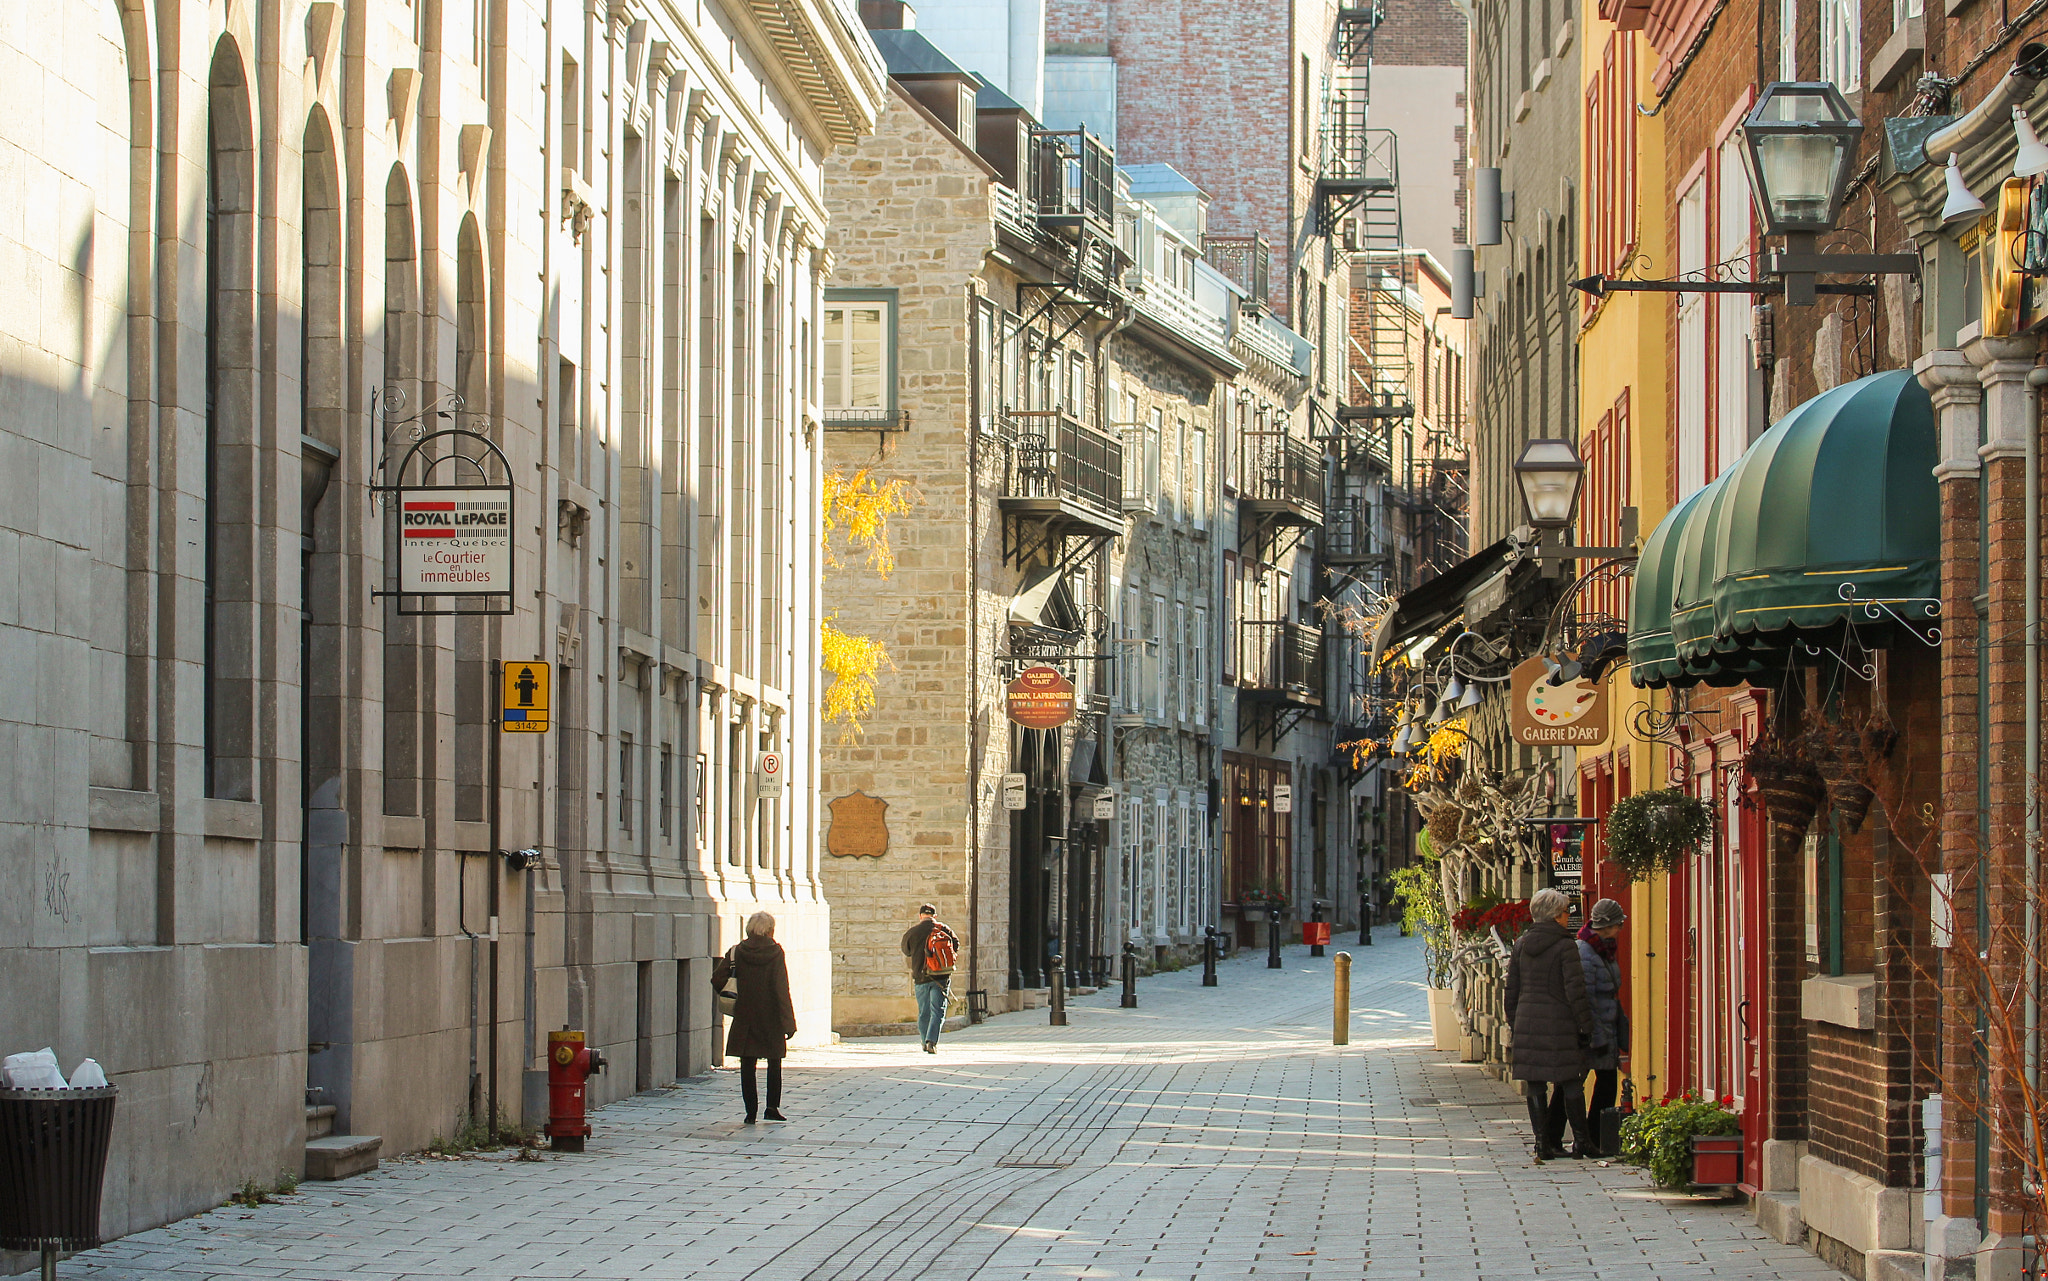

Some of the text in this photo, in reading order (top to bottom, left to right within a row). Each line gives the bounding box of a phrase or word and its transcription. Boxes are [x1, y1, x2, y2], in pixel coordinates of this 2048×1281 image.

[404, 512, 451, 526] ROYAL
[404, 539, 507, 547] Inter-Québec
[434, 550, 486, 564] Courtier
[449, 563, 461, 572] en
[420, 569, 491, 583] immeubles
[514, 722, 538, 730] 3142
[1522, 725, 1600, 741] GALERIE D'ART
[1553, 863, 1583, 871] GALERIE
